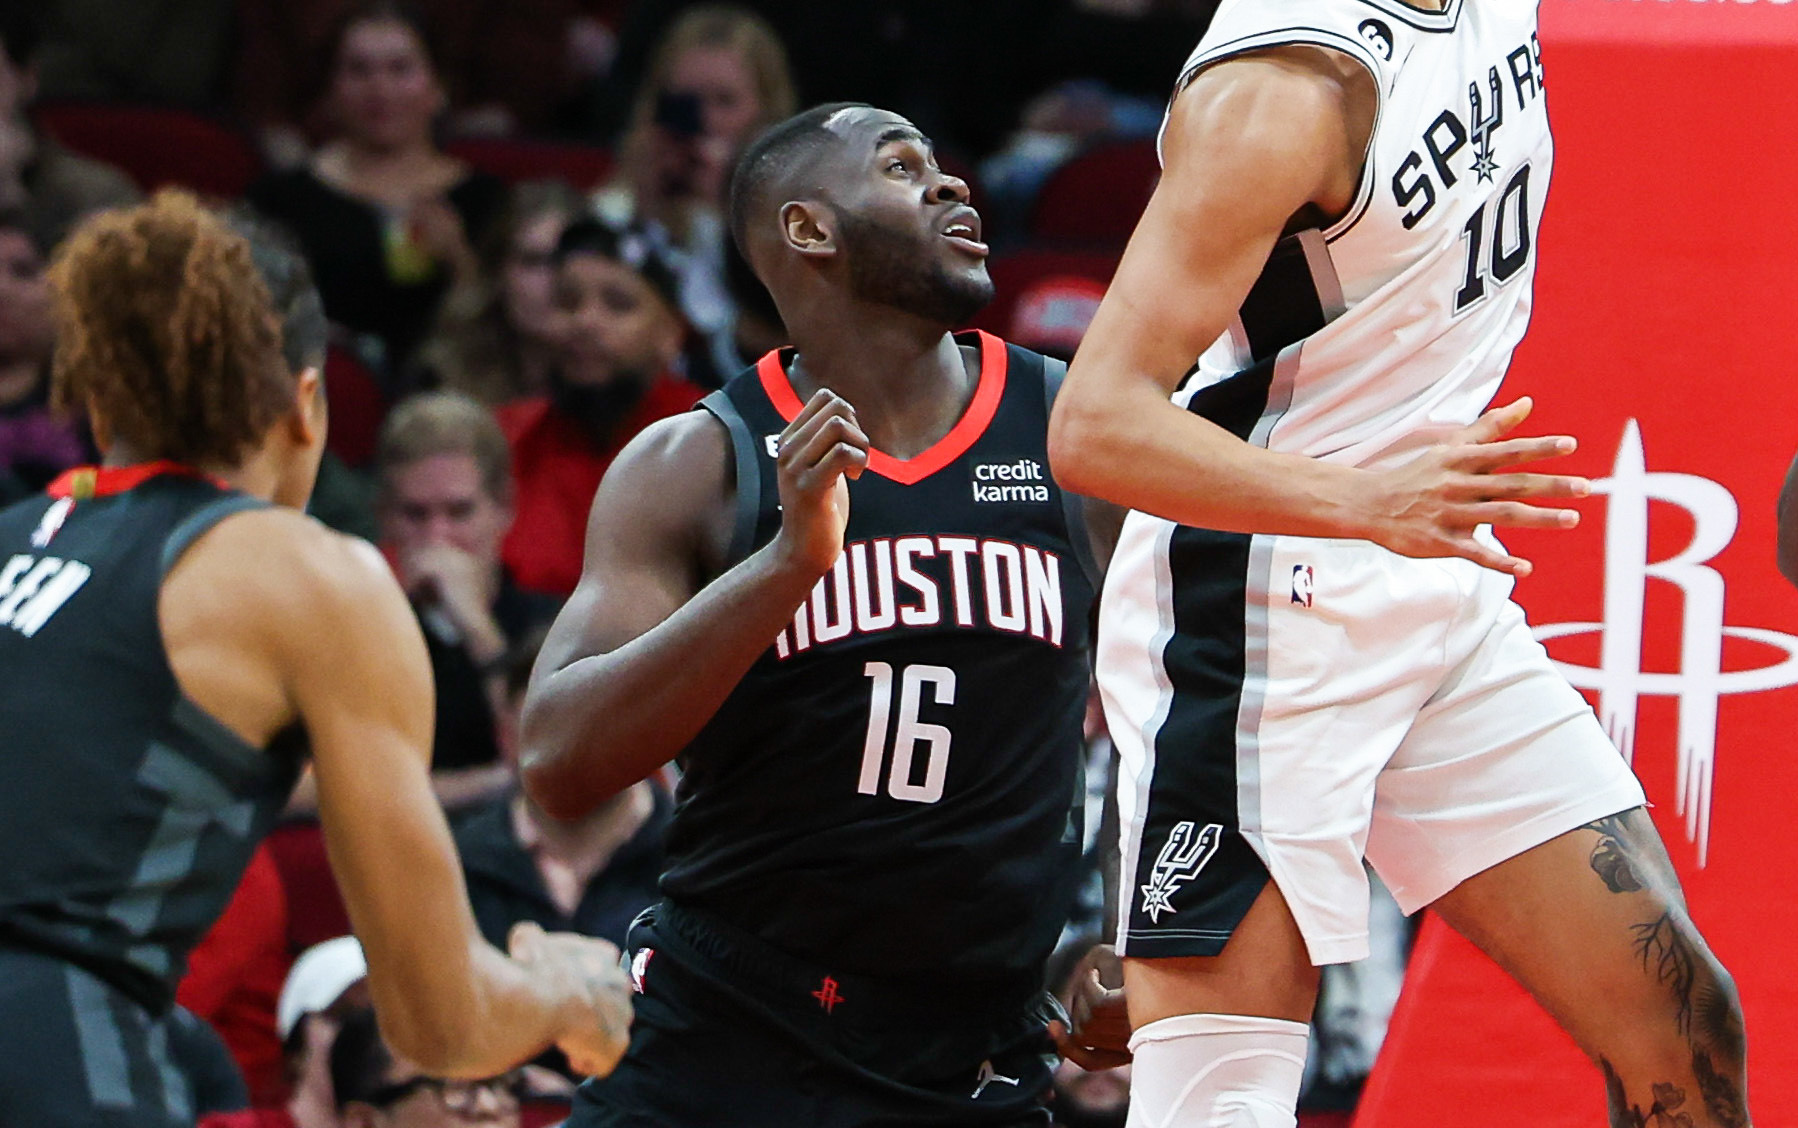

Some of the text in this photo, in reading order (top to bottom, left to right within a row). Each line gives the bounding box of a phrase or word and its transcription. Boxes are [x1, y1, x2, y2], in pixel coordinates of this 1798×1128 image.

[1452, 159, 1532, 314] 10
[972, 481, 1049, 503] karma
[975, 459, 1043, 481] credit
[857, 661, 957, 804] 16
